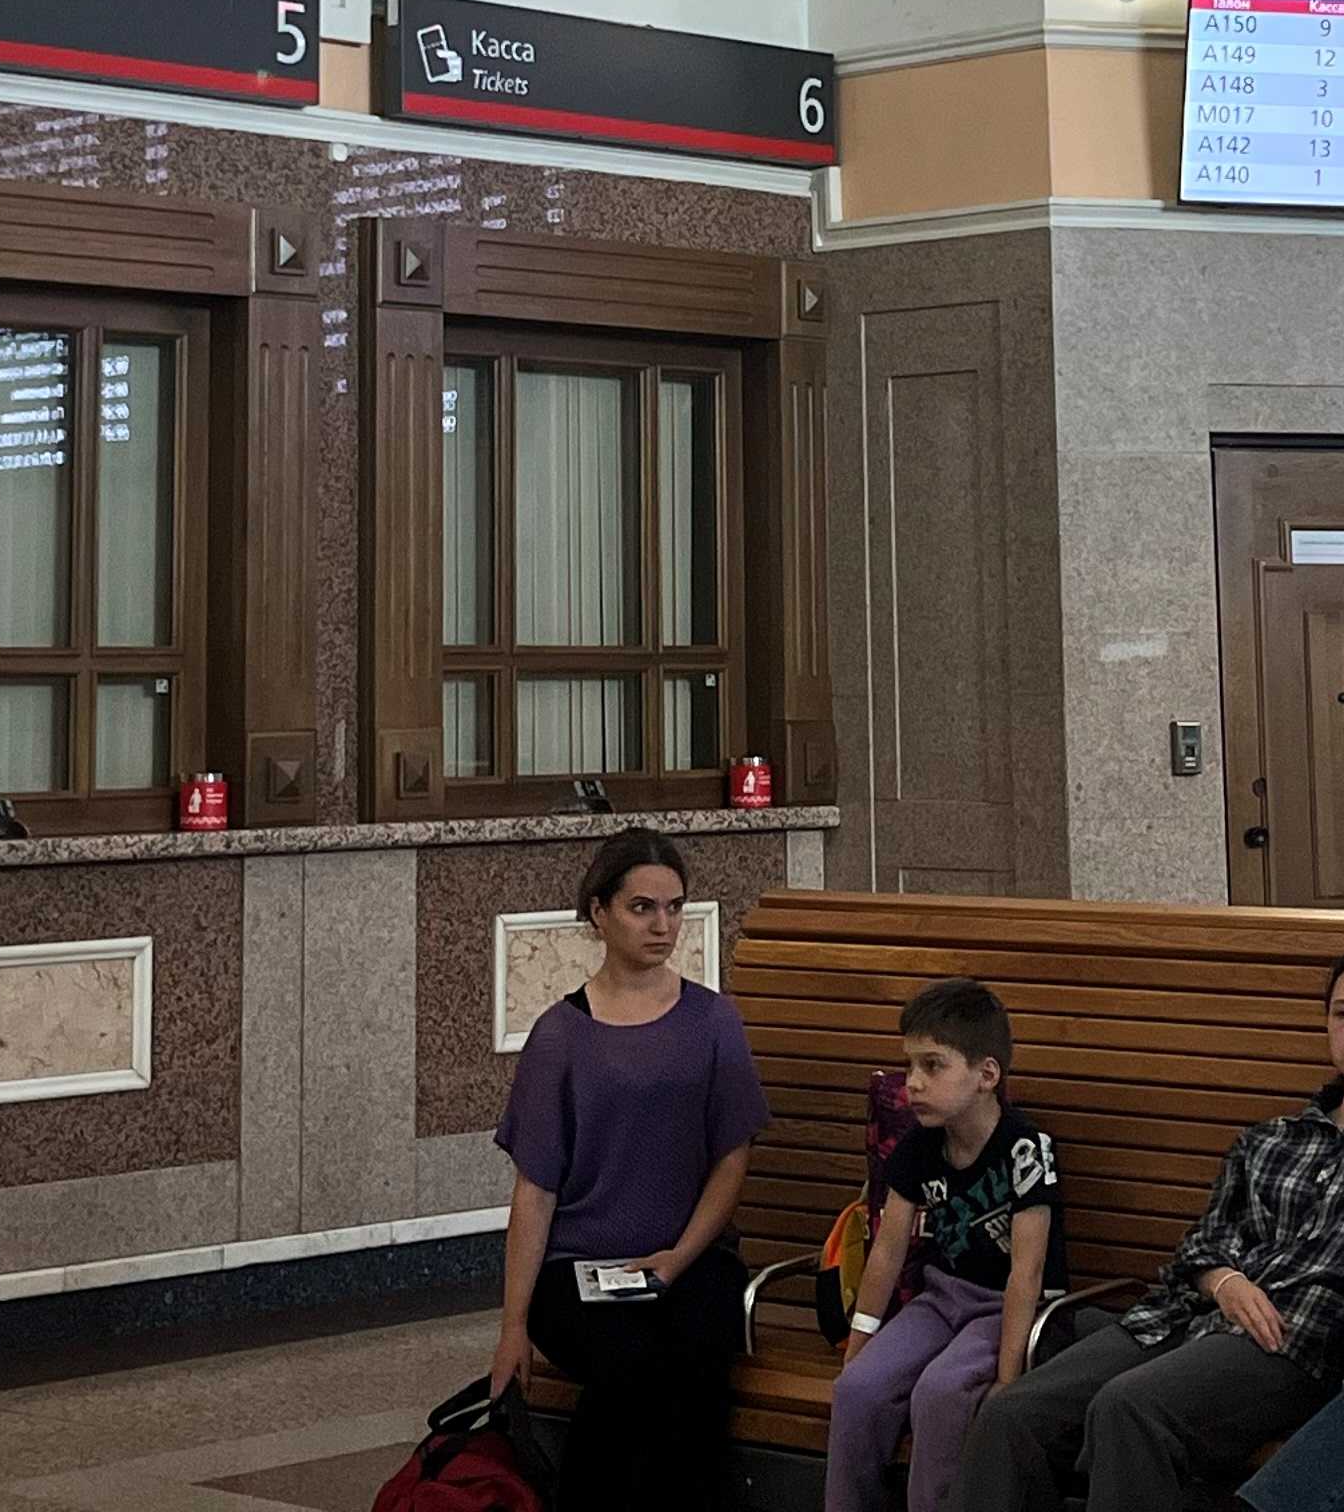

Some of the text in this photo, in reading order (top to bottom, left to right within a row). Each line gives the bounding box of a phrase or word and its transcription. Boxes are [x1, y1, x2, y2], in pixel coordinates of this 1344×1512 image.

[274, 0, 307, 66] 5
[1320, 20, 1332, 38] 9
[470, 30, 535, 66] Касса
[1315, 49, 1336, 68] 12
[471, 67, 529, 98] Tickets
[1316, 80, 1328, 98] 3
[797, 77, 824, 136] 6
[1312, 109, 1333, 128] 10
[1309, 140, 1331, 159] 13
[1314, 169, 1322, 186] 1
